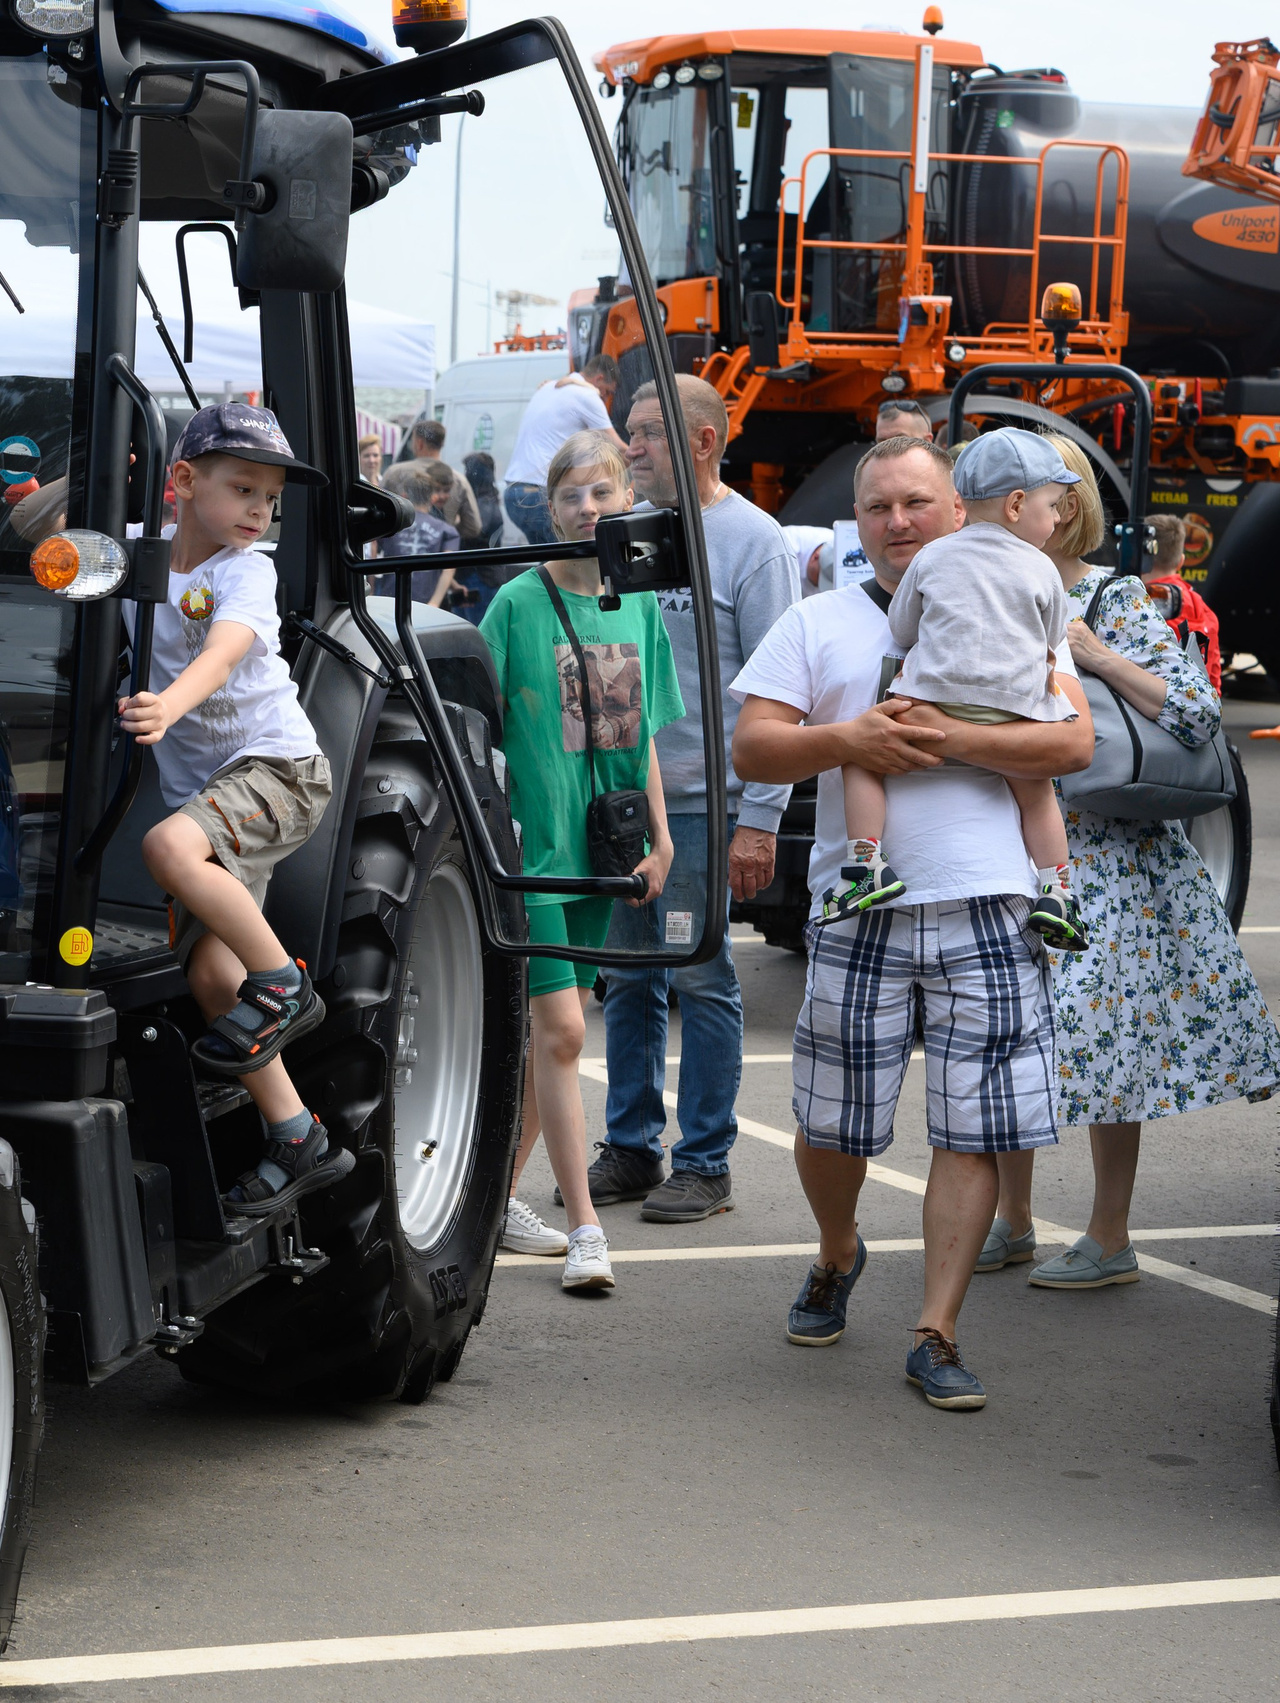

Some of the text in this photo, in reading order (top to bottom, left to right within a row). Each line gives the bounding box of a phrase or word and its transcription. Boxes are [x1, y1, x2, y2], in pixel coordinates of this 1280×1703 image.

[1221, 213, 1276, 231] Uniport
[1235, 230, 1276, 243] 4530
[1151, 491, 1189, 504] KEBAB
[1206, 493, 1239, 506] FRIES
